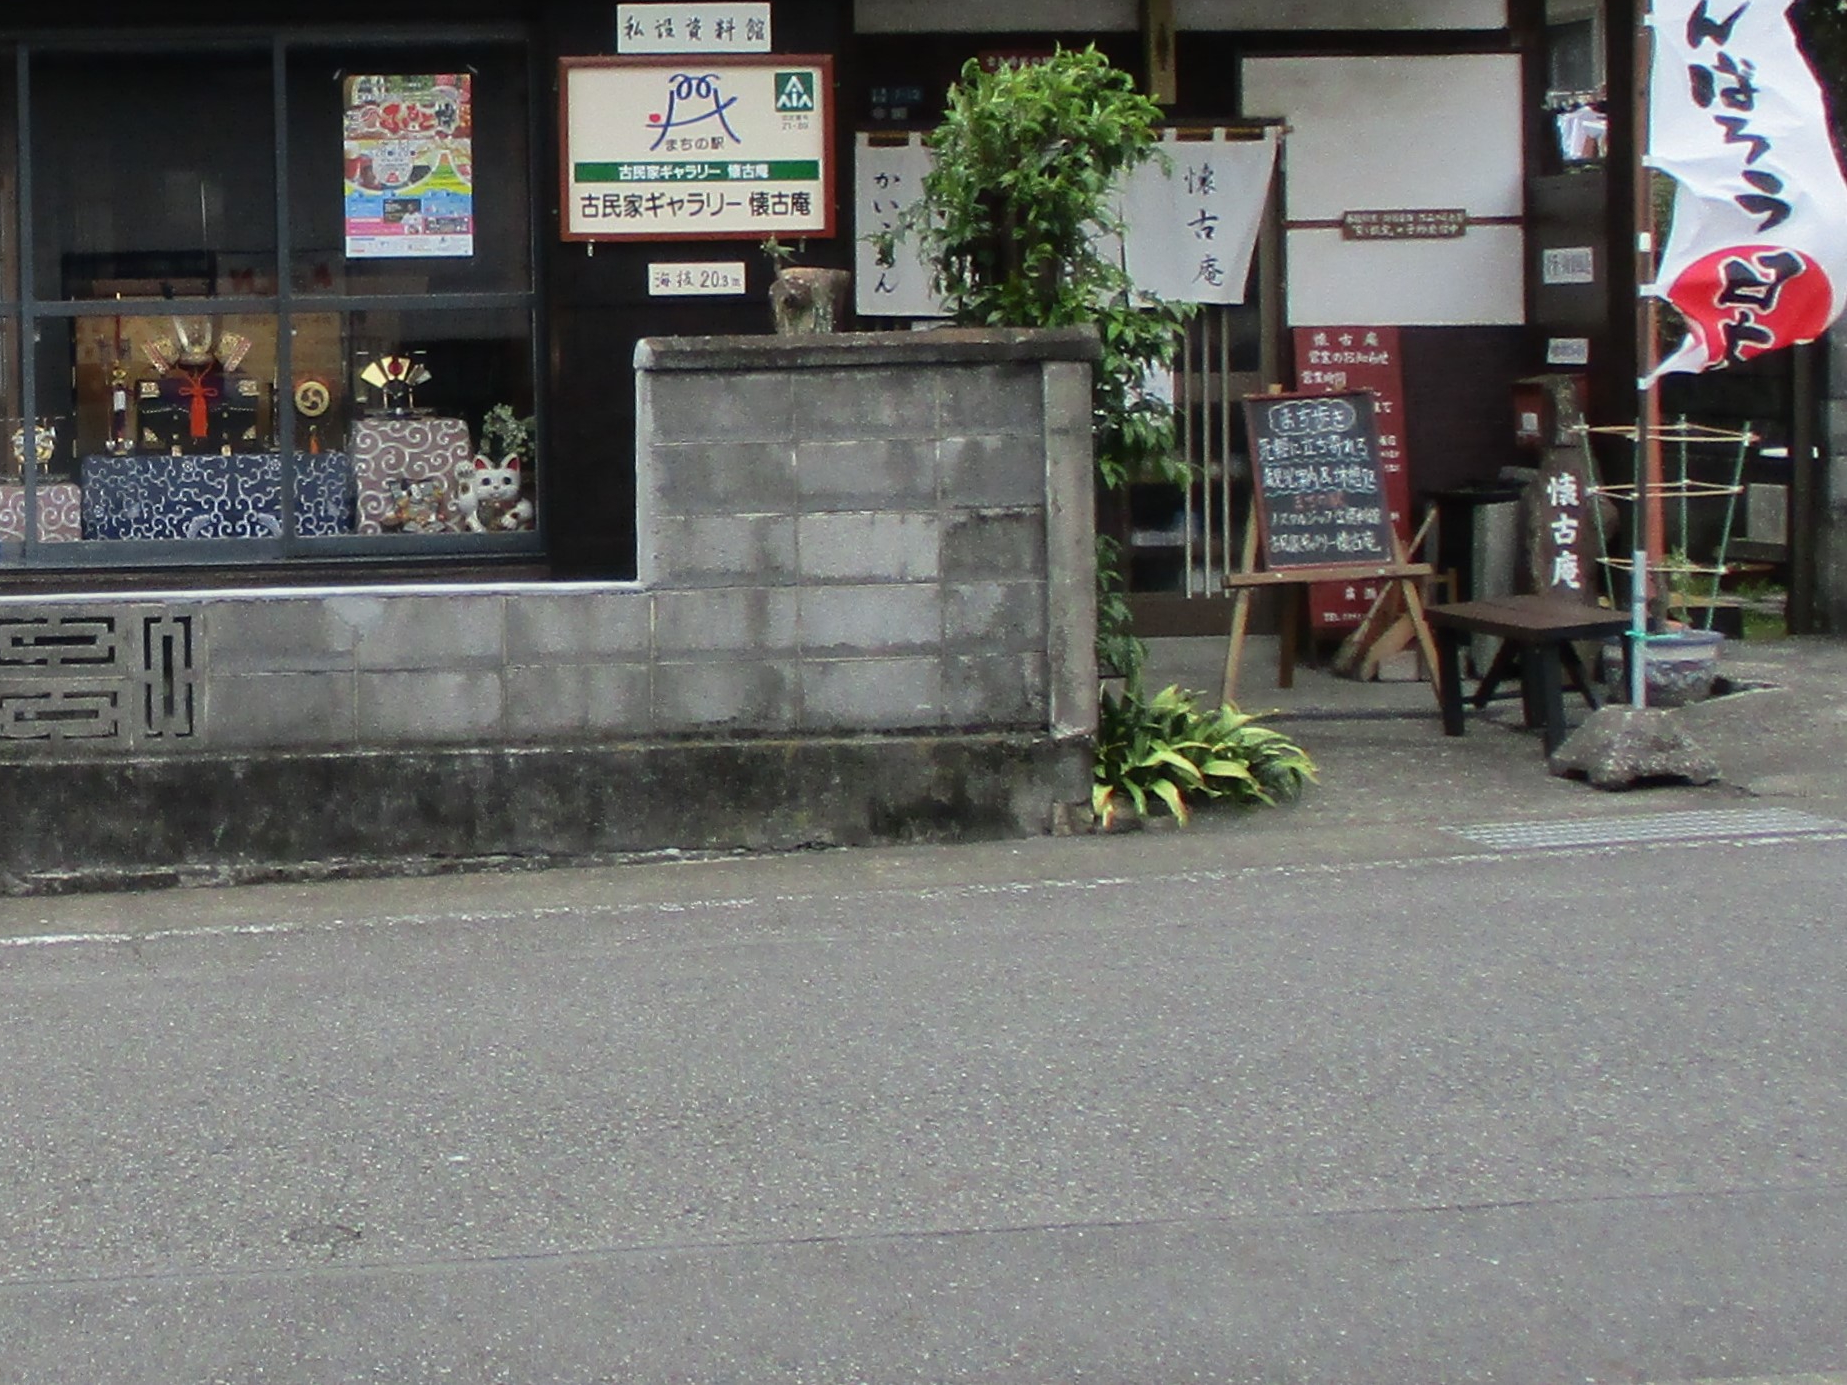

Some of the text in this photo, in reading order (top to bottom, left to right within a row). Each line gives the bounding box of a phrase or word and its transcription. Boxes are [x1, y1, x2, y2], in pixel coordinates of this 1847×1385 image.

[623, 17, 765, 42] 私設資料館
[665, 137, 724, 152] まちの駅
[618, 164, 769, 180] 古民家ギャラリー 懐古庵
[580, 190, 812, 218] 古民家ギャラリー 懐古庵
[1184, 162, 1225, 288] 懐古庵
[1546, 476, 1582, 589] 懐古庵
